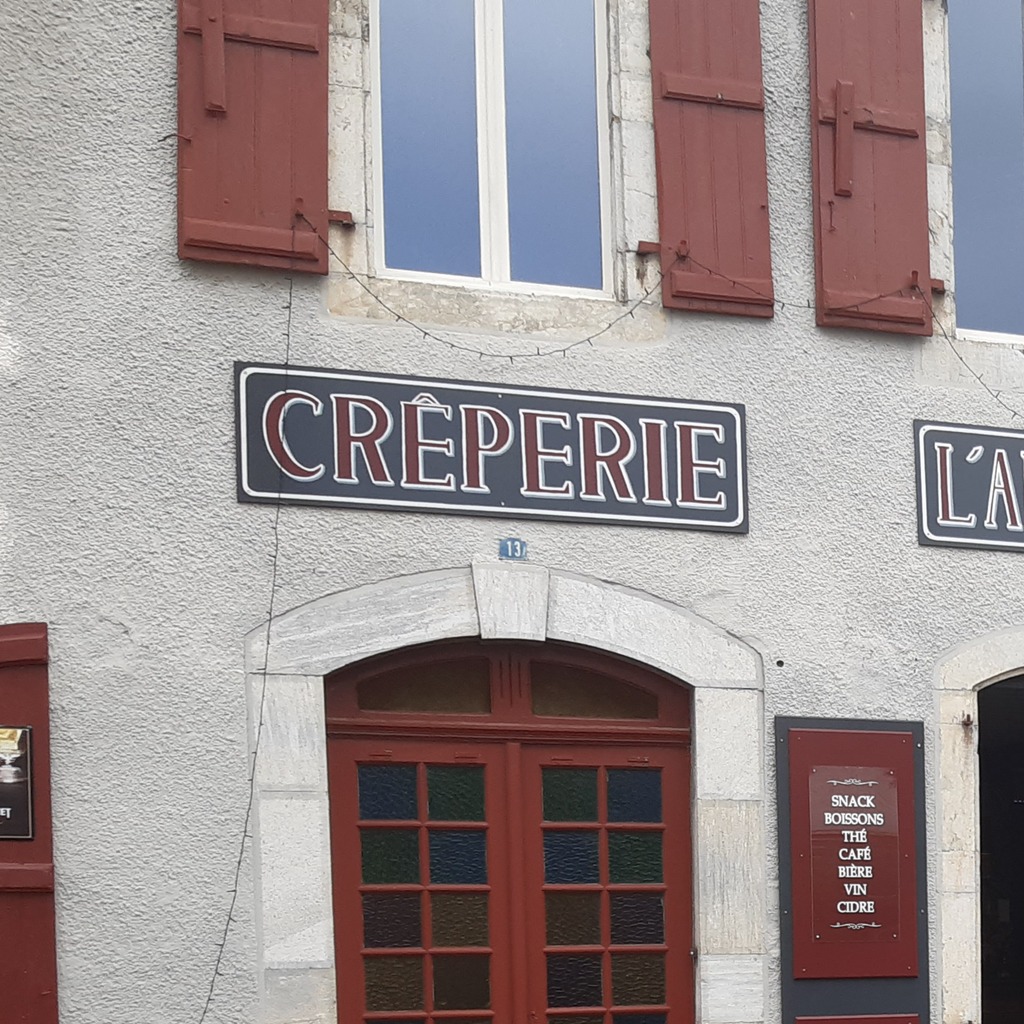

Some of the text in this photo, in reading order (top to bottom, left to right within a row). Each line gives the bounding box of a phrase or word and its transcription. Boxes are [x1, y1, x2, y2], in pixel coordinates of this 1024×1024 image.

[262, 390, 727, 511] CRÊPERIE
[831, 795, 875, 808] SNACK
[824, 812, 884, 826] BOISSONS
[842, 828, 867, 843] THÉ
[838, 846, 871, 861] CAFÉ
[838, 864, 873, 878] BIÈRE
[844, 884, 867, 896] VIN
[836, 901, 875, 914] CIDRE
